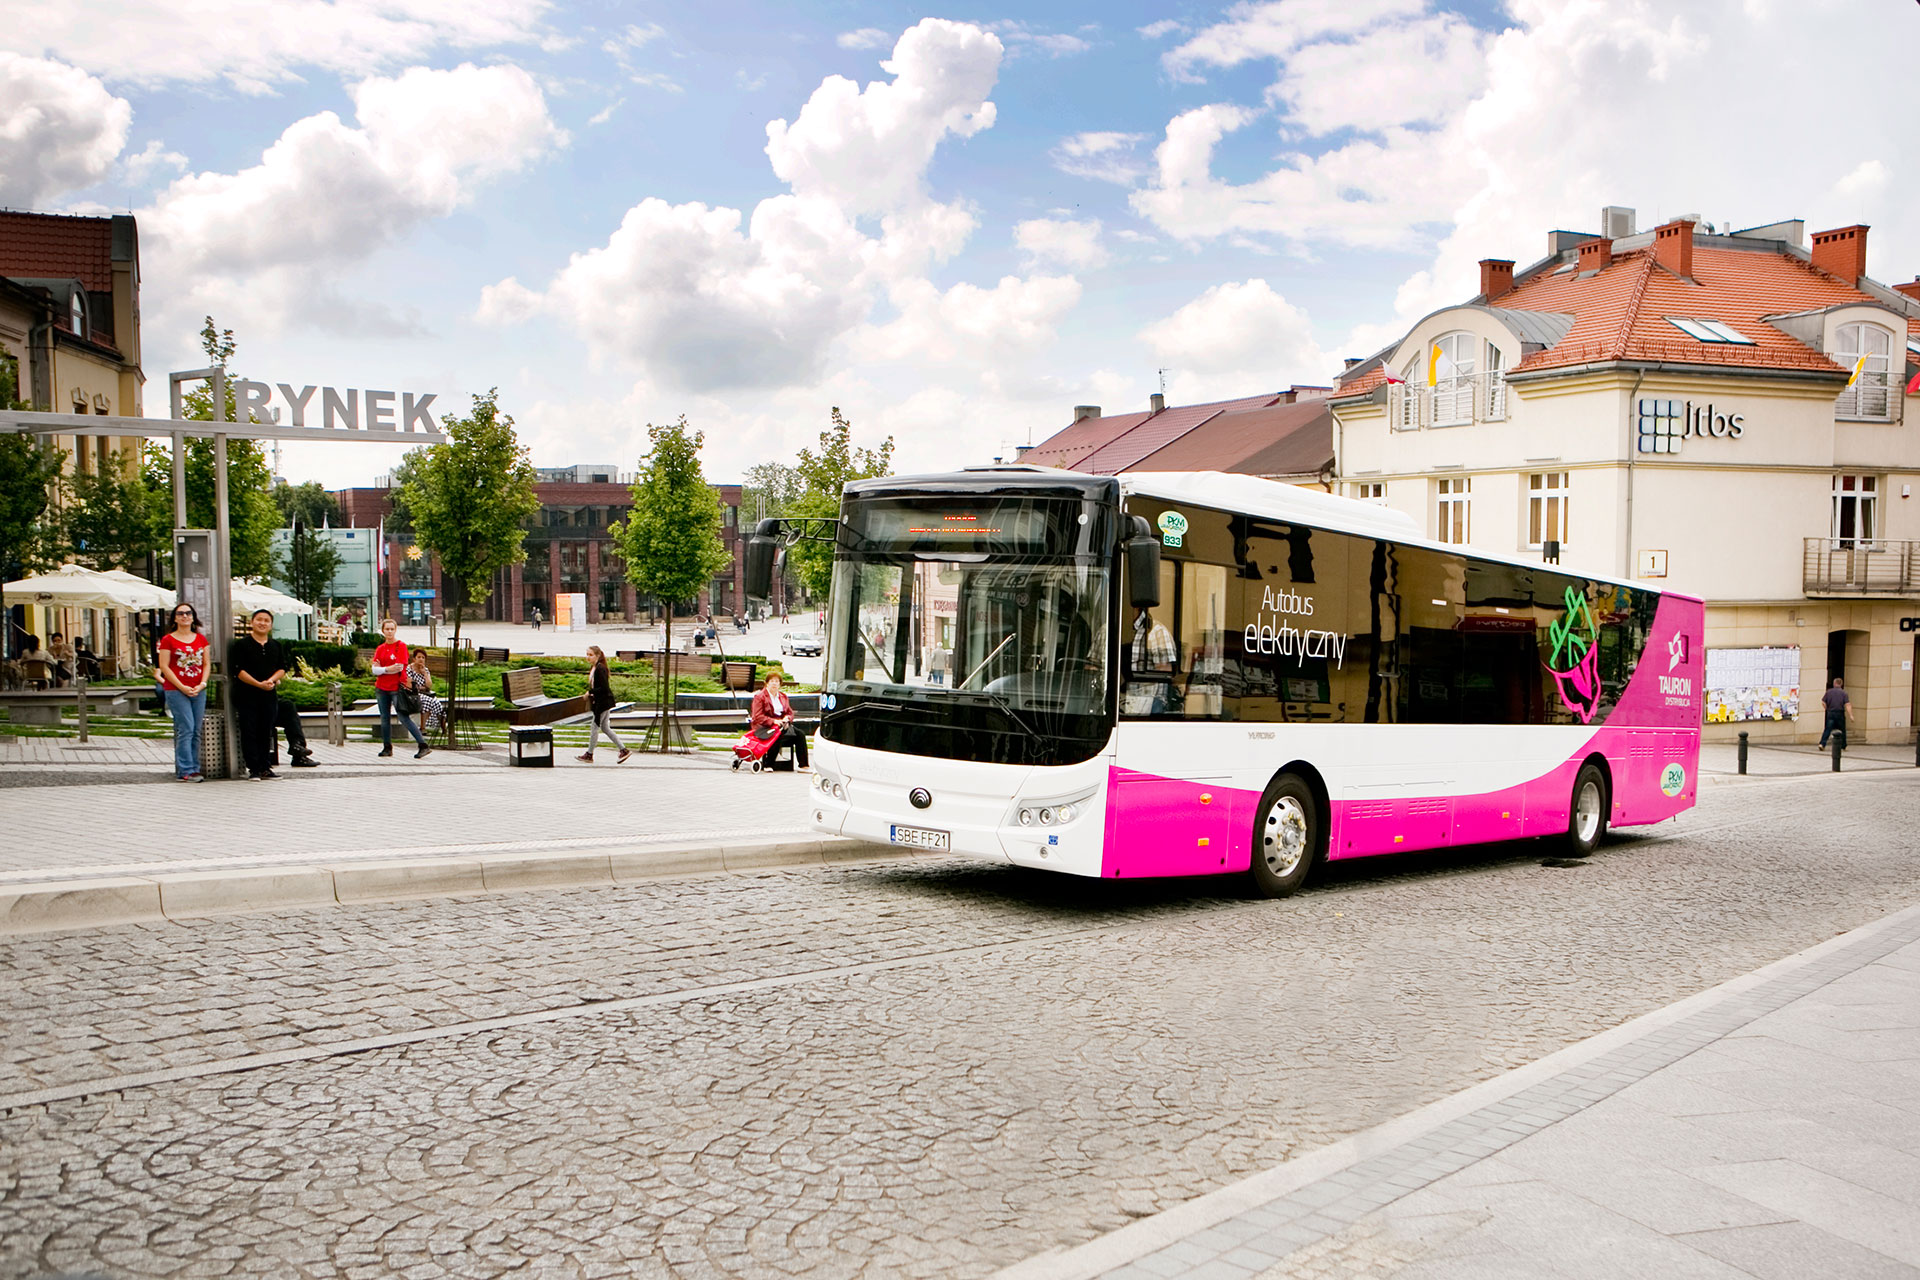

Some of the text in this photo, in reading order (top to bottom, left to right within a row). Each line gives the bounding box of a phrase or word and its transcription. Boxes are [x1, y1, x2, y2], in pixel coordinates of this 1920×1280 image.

[232, 380, 441, 434] RYNEK
[1681, 400, 1744, 440] jtbs
[1164, 535, 1181, 546] 933
[1650, 555, 1656, 569] 1
[1261, 585, 1314, 616] Autobus
[1244, 612, 1347, 671] elektryczny
[1658, 675, 1691, 697] TAURON
[897, 828, 919, 843] SBE
[921, 831, 946, 847] FF21
